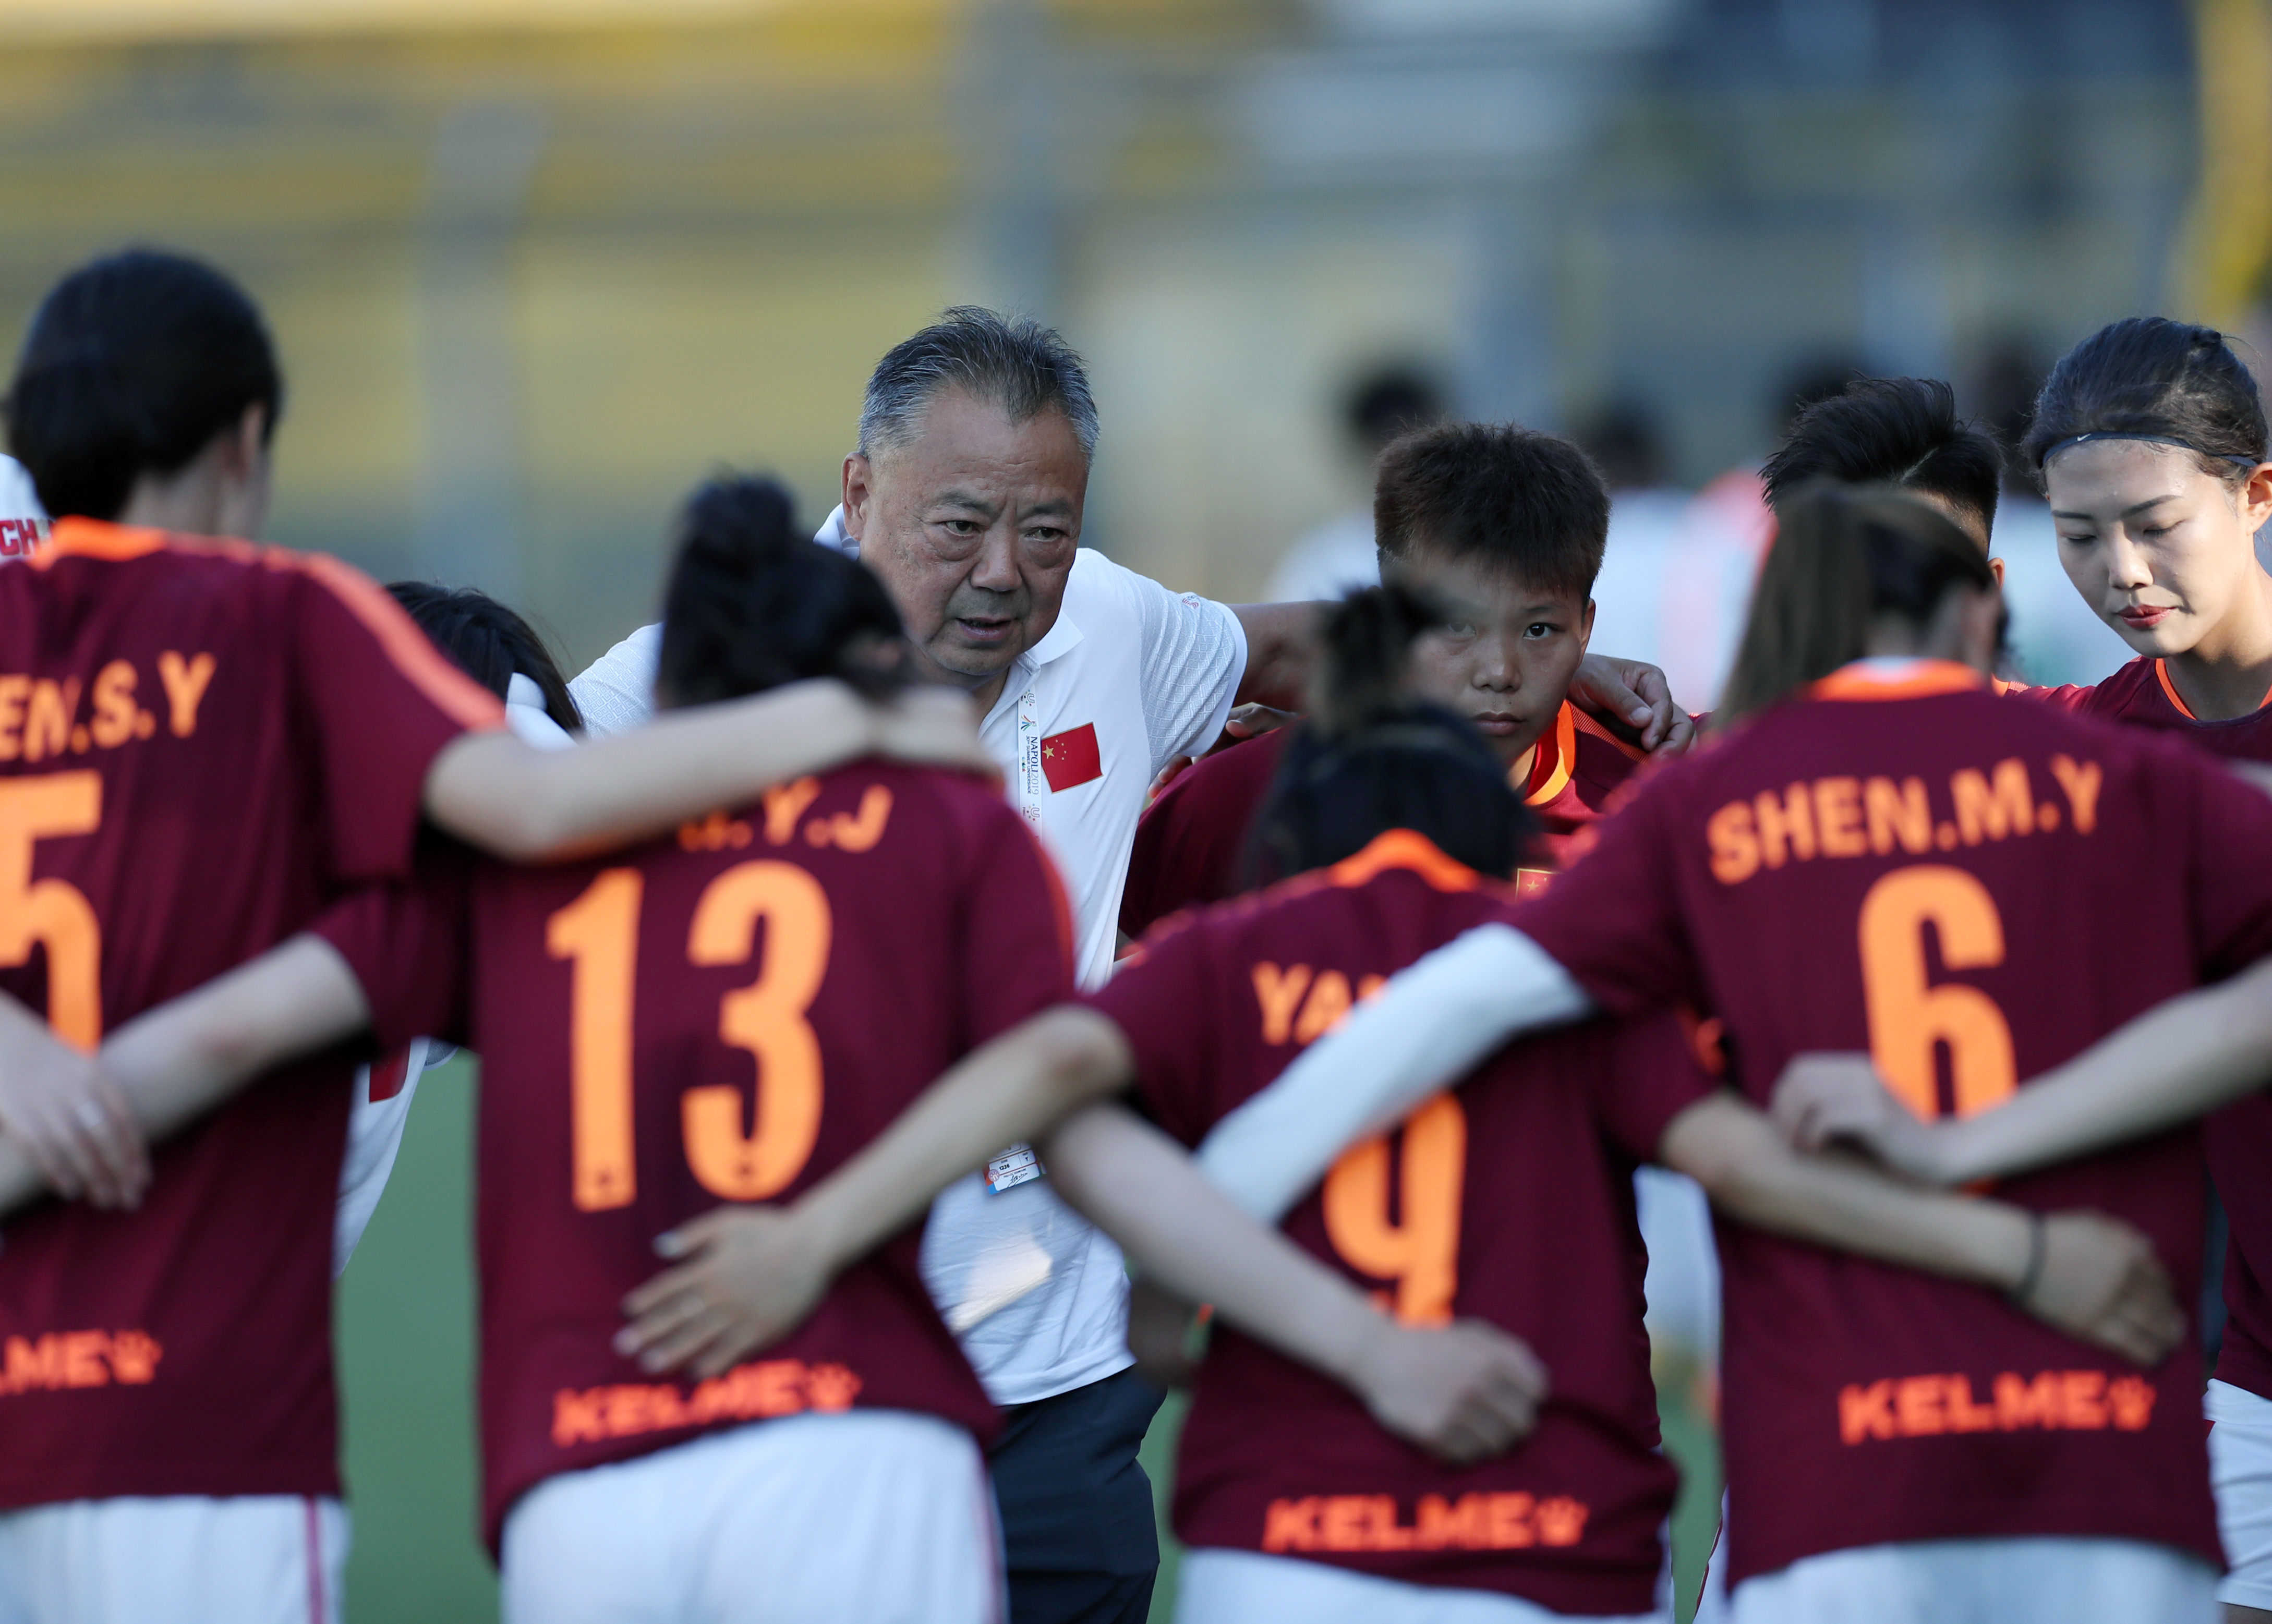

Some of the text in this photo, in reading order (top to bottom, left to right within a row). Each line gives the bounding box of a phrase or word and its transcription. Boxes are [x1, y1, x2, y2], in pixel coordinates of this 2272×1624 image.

[1030, 736, 1040, 795] NAPOLI2019
[1707, 754, 2102, 886] SHEN.M.Y
[545, 858, 833, 1213] 13
[1252, 960, 1390, 1045] YA
[1858, 863, 2017, 1129] 6
[1322, 1088, 1467, 1331] 9
[0, 1329, 110, 1395] ME
[551, 1359, 807, 1447] KELME
[1838, 1370, 2109, 1446] KELME
[1262, 1491, 1536, 1553] KELME
